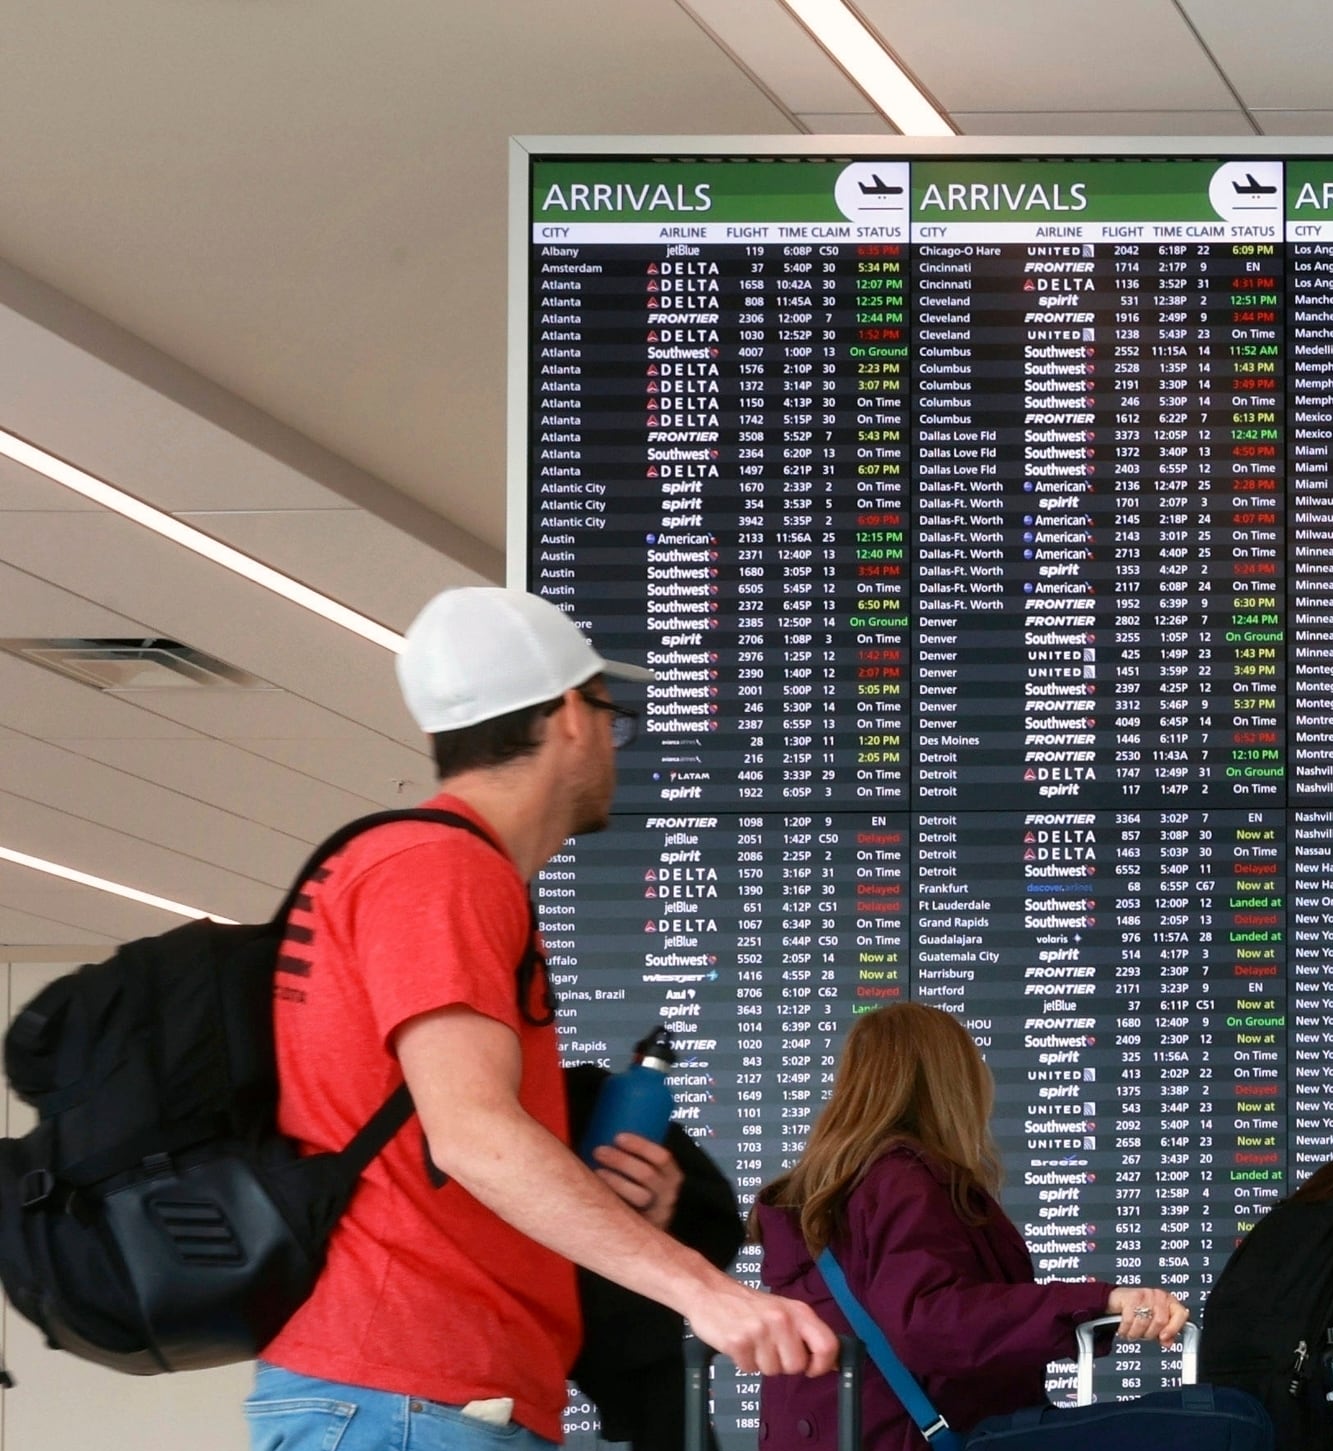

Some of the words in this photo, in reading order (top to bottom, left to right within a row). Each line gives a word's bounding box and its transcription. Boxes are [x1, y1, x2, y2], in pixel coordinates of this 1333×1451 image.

[542, 184, 711, 210] ARRIVALS
[920, 184, 1086, 210] ARRIVALS
[542, 228, 569, 237] CITY
[660, 228, 706, 238] AIRLINE
[727, 227, 768, 238] FLIGHT
[778, 227, 807, 237] TIME
[811, 227, 850, 237] CLAIM
[857, 227, 901, 237] STATUS
[920, 246, 973, 258] Chicago-O
[976, 246, 1001, 255] Hare
[1028, 247, 1080, 255] UNITED
[1115, 246, 1139, 255] 2042
[1159, 246, 1187, 255] 6:18P
[1198, 246, 1209, 255] 22
[1233, 245, 1254, 254] 6:09
[1257, 245, 1273, 254] PM
[541, 264, 602, 272] Amsterdam
[661, 262, 719, 274] DELTA
[752, 263, 763, 272] 37
[784, 263, 812, 272] 5:40P
[823, 263, 835, 272] 30
[859, 263, 880, 272] 5:34
[883, 263, 899, 272] PM
[1296, 412, 1331, 421] Mexico
[919, 935, 982, 946] Guadalajara
[1122, 933, 1140, 942] 976
[1154, 932, 1188, 942] 11:57A
[1200, 932, 1212, 941] 28
[1230, 931, 1267, 941] Landed
